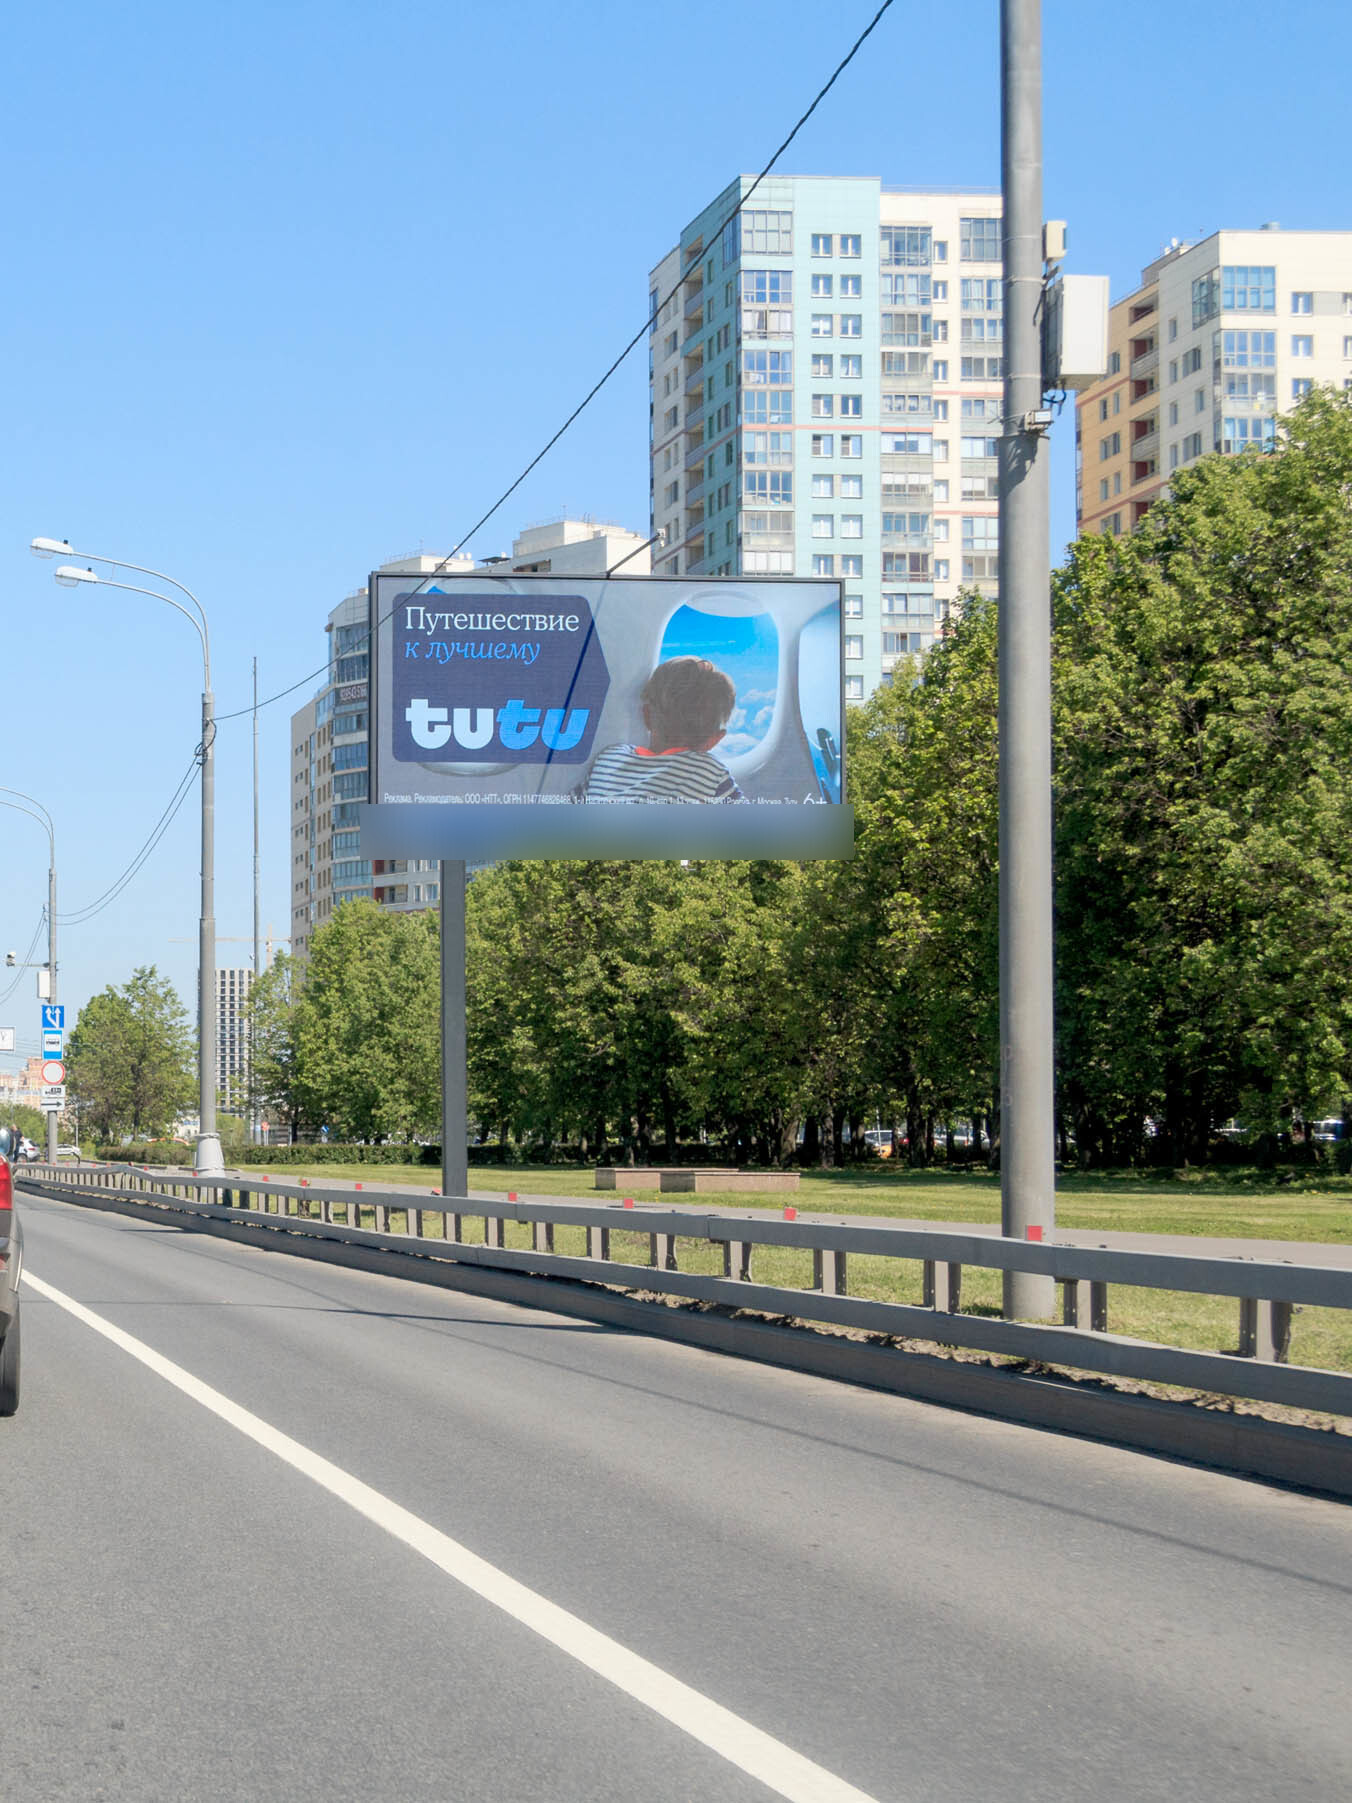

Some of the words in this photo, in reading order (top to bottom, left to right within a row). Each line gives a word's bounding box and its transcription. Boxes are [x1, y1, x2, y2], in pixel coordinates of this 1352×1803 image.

[405, 606, 579, 635] Путешествие
[404, 641, 420, 659] к
[425, 641, 541, 665] лучшему
[405, 698, 590, 750] tutu
